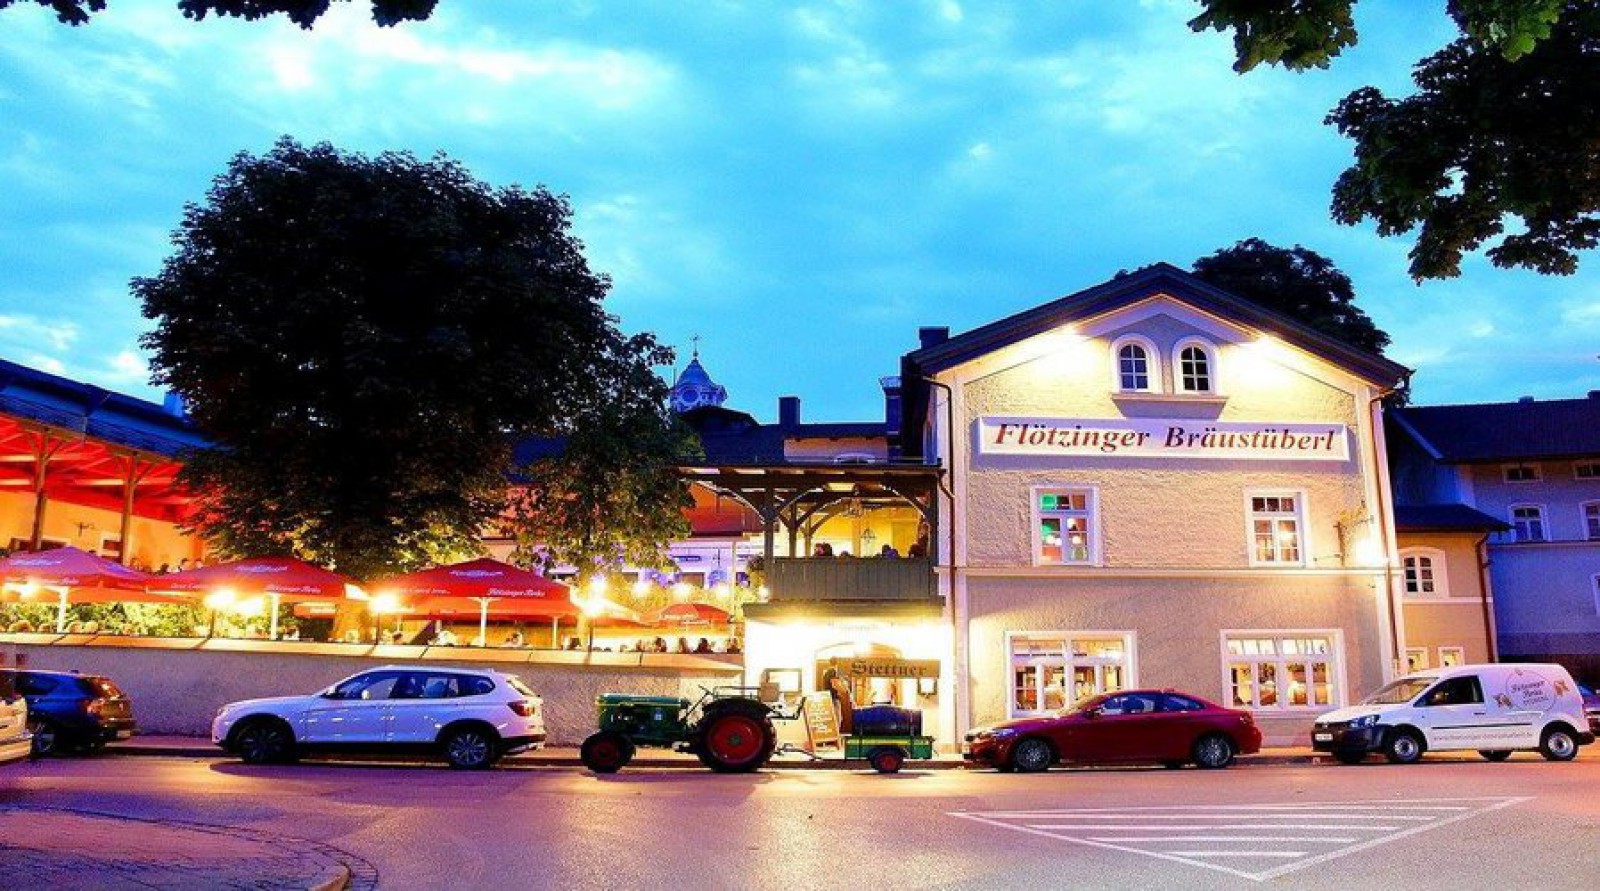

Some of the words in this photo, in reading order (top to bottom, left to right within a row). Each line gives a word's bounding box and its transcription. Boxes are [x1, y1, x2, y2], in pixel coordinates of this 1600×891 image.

[994, 423, 1151, 453] Flötzinger
[1164, 426, 1335, 450] Bräustüberl
[851, 660, 927, 676] Stettner
